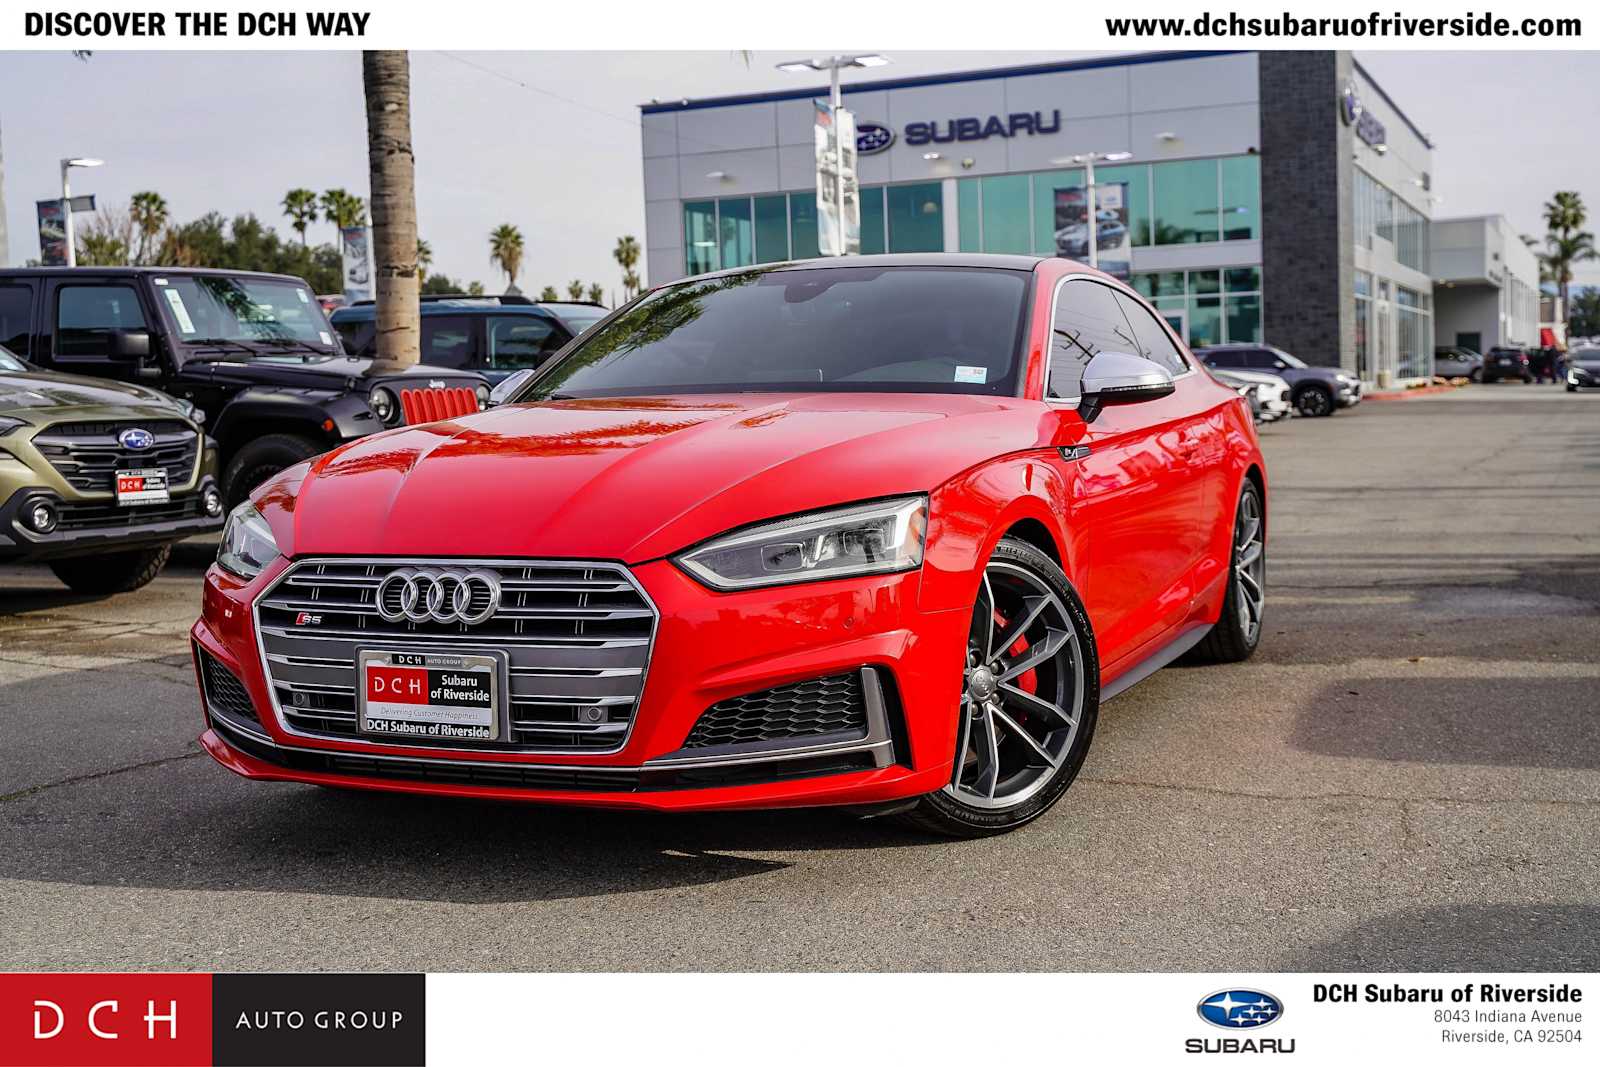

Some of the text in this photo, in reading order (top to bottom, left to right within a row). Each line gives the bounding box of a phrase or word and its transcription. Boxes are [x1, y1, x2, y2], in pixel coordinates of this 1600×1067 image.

[905, 109, 1061, 146] SUBARU
[398, 655, 422, 665] DCH
[374, 676, 421, 695] DCH
[441, 674, 478, 687] Subaru
[430, 688, 490, 702] of Riverside
[367, 719, 490, 738] DCH Subaru of Riverside
